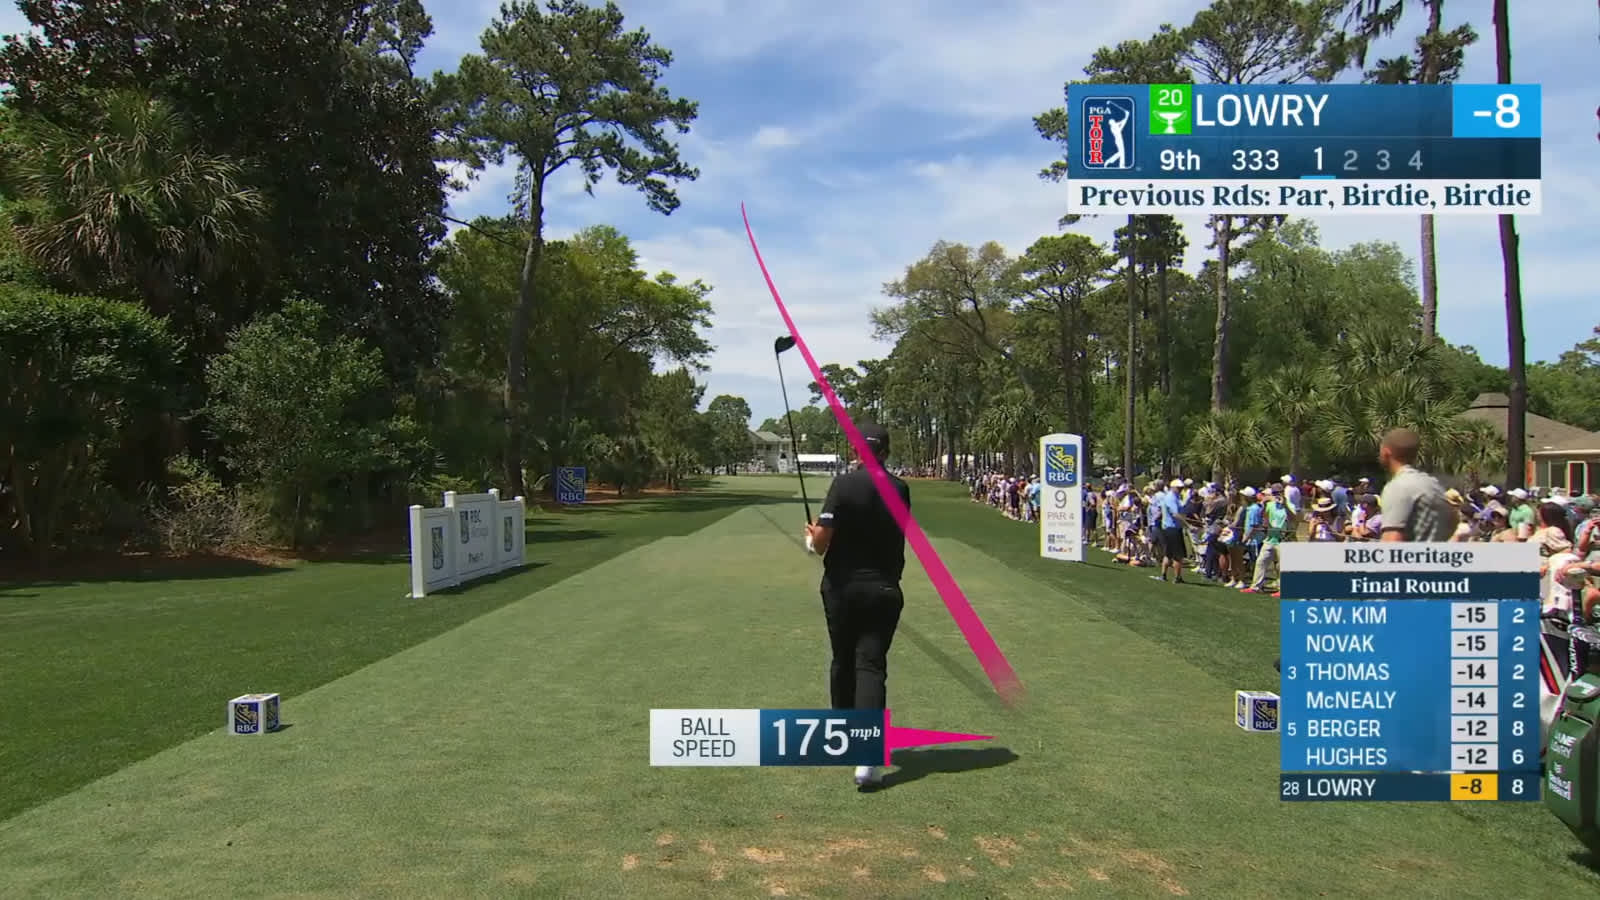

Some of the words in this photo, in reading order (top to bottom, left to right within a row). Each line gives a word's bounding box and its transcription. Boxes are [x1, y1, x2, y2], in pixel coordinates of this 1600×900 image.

[1049, 472, 1073, 481] RBC
[560, 493, 582, 501] RBC
[1054, 490, 1067, 509] 9
[1047, 512, 1067, 520] PAR
